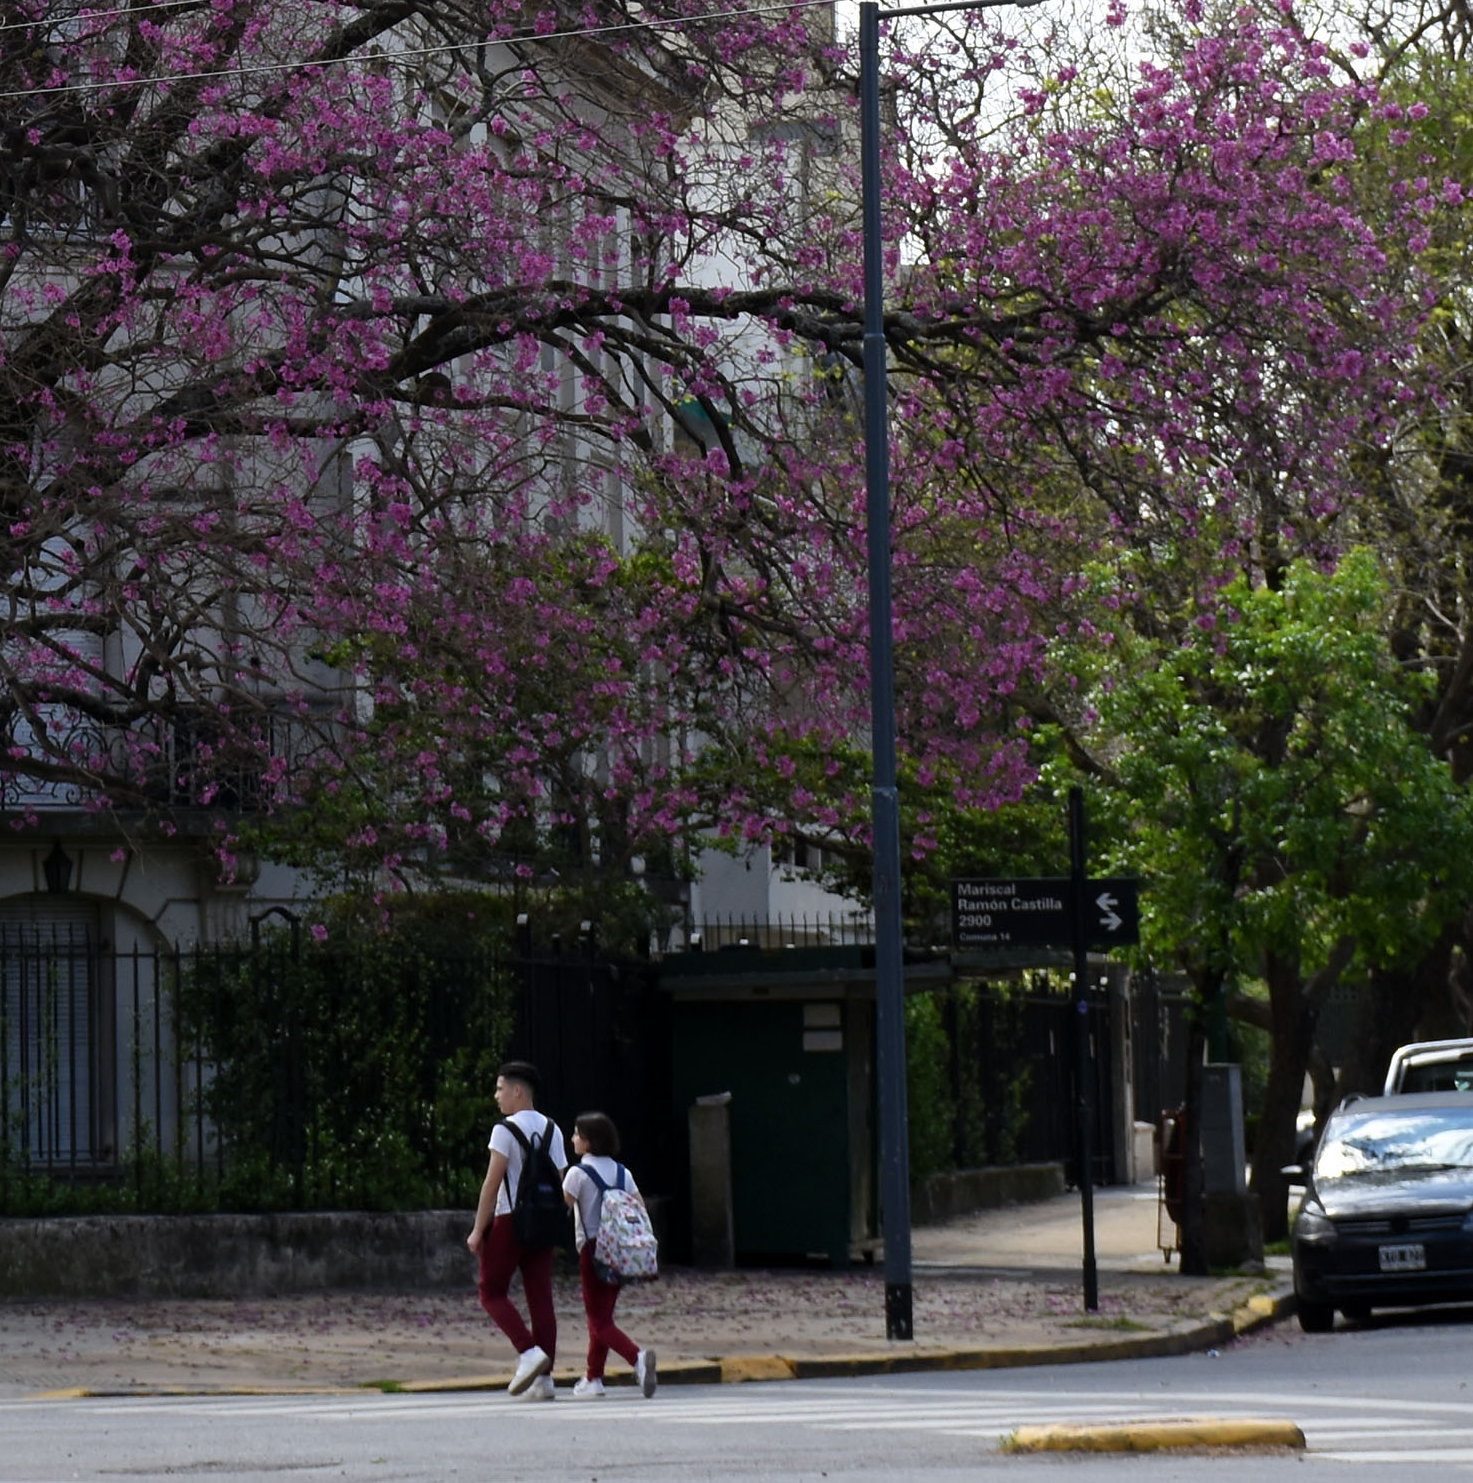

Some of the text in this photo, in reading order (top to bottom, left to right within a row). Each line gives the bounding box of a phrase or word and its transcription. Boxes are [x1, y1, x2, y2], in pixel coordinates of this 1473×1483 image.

[957, 883, 1016, 895] Mariscal
[957, 897, 1062, 910] Ramón Castilla
[959, 914, 992, 927] 2900
